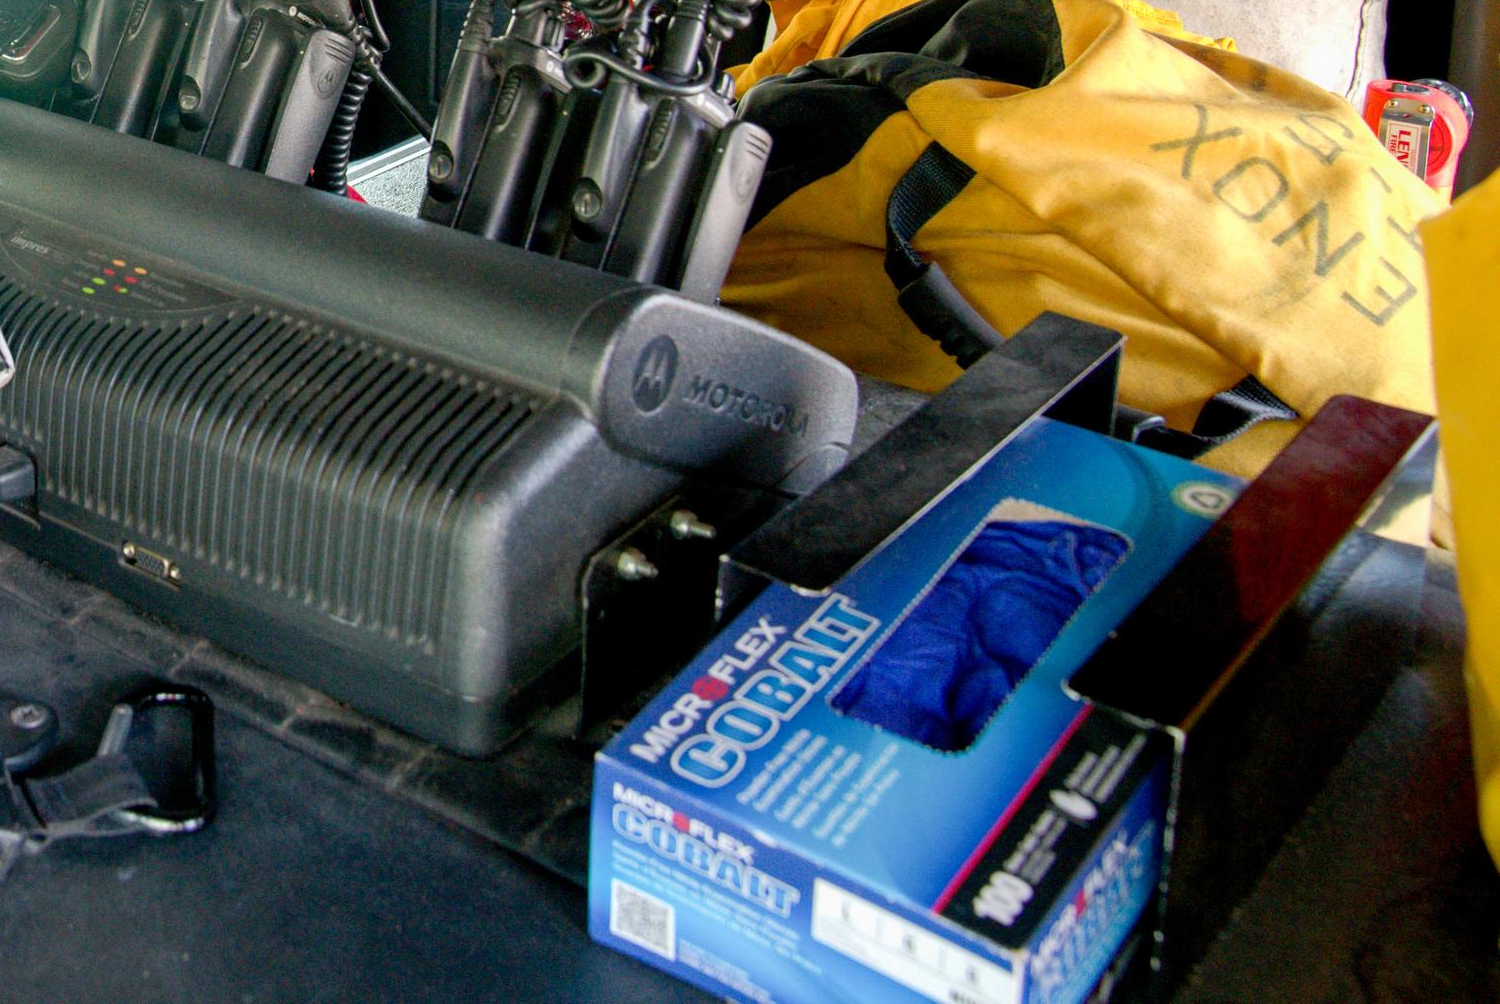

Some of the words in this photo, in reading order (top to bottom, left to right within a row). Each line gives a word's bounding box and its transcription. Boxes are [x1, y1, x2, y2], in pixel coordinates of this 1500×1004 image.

[1397, 130, 1412, 167] LEN
[630, 616, 786, 763] MICROFLEX
[670, 593, 881, 788] COBALT
[611, 803, 801, 919] COBALT
[612, 782, 755, 864] MICROFLEX
[972, 870, 1034, 927] 100
